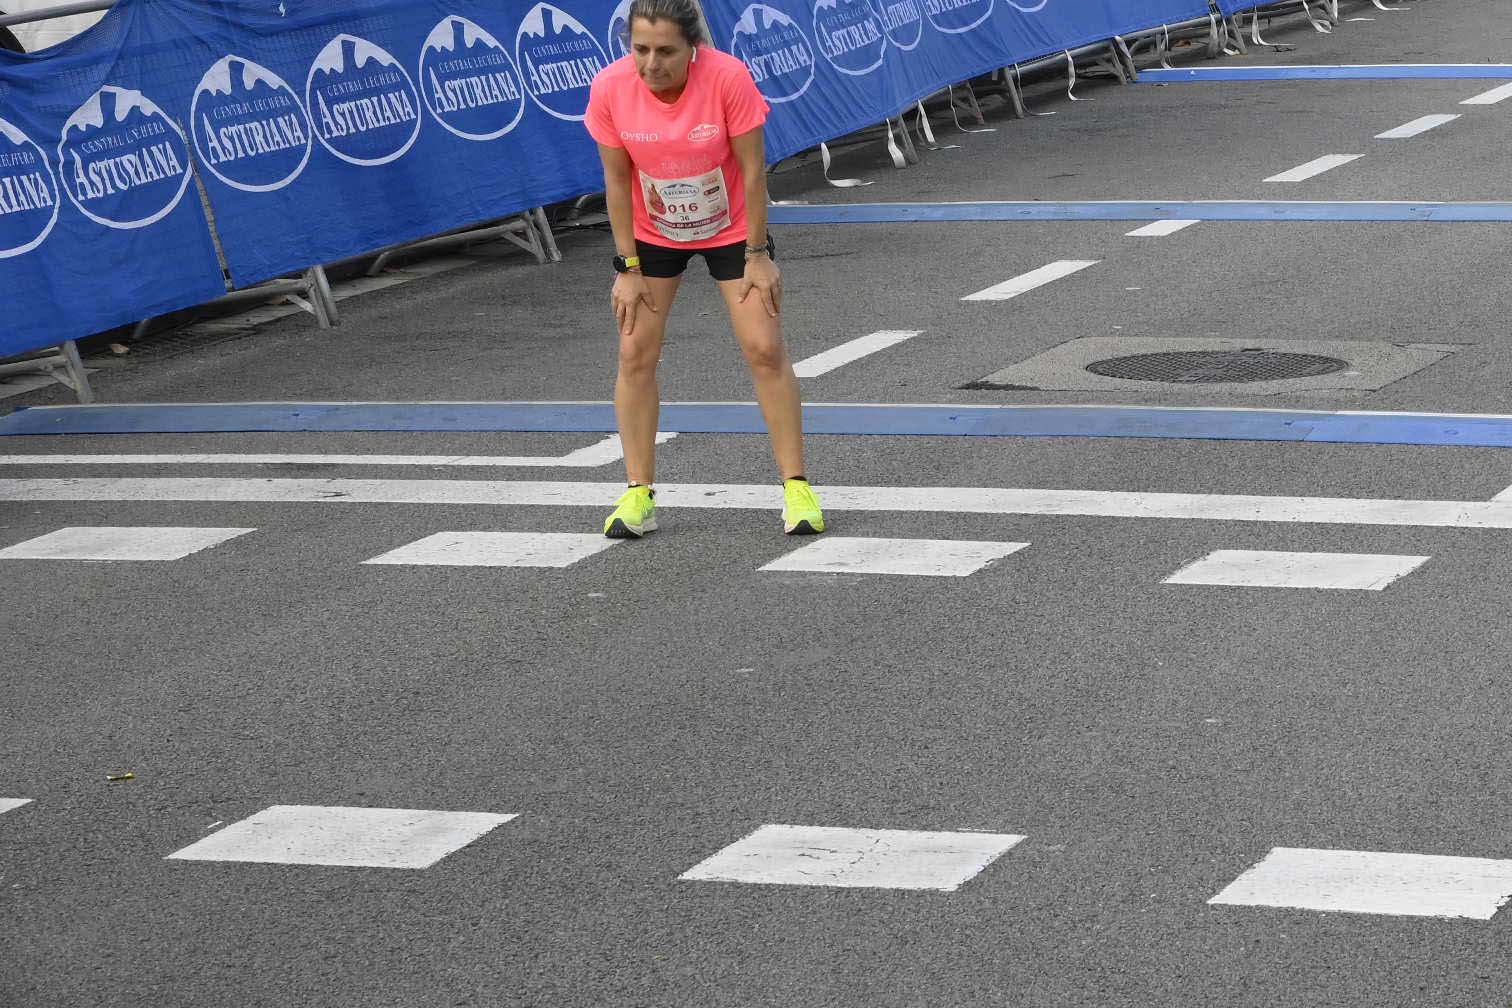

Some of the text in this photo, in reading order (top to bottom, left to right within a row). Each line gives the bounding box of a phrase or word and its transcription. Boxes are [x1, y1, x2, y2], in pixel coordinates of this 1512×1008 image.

[438, 59, 472, 73] CENTRAL
[327, 72, 401, 96] CENTRAL LECHERA
[429, 66, 520, 113] ASTURIANA
[213, 104, 253, 119] CENTRAL
[317, 89, 416, 139] ASTURIANA
[82, 135, 123, 154] CENTRAL
[203, 113, 307, 164] ASTURIANA
[621, 132, 658, 142] OYSHO
[70, 141, 183, 201] ASTURIANA
